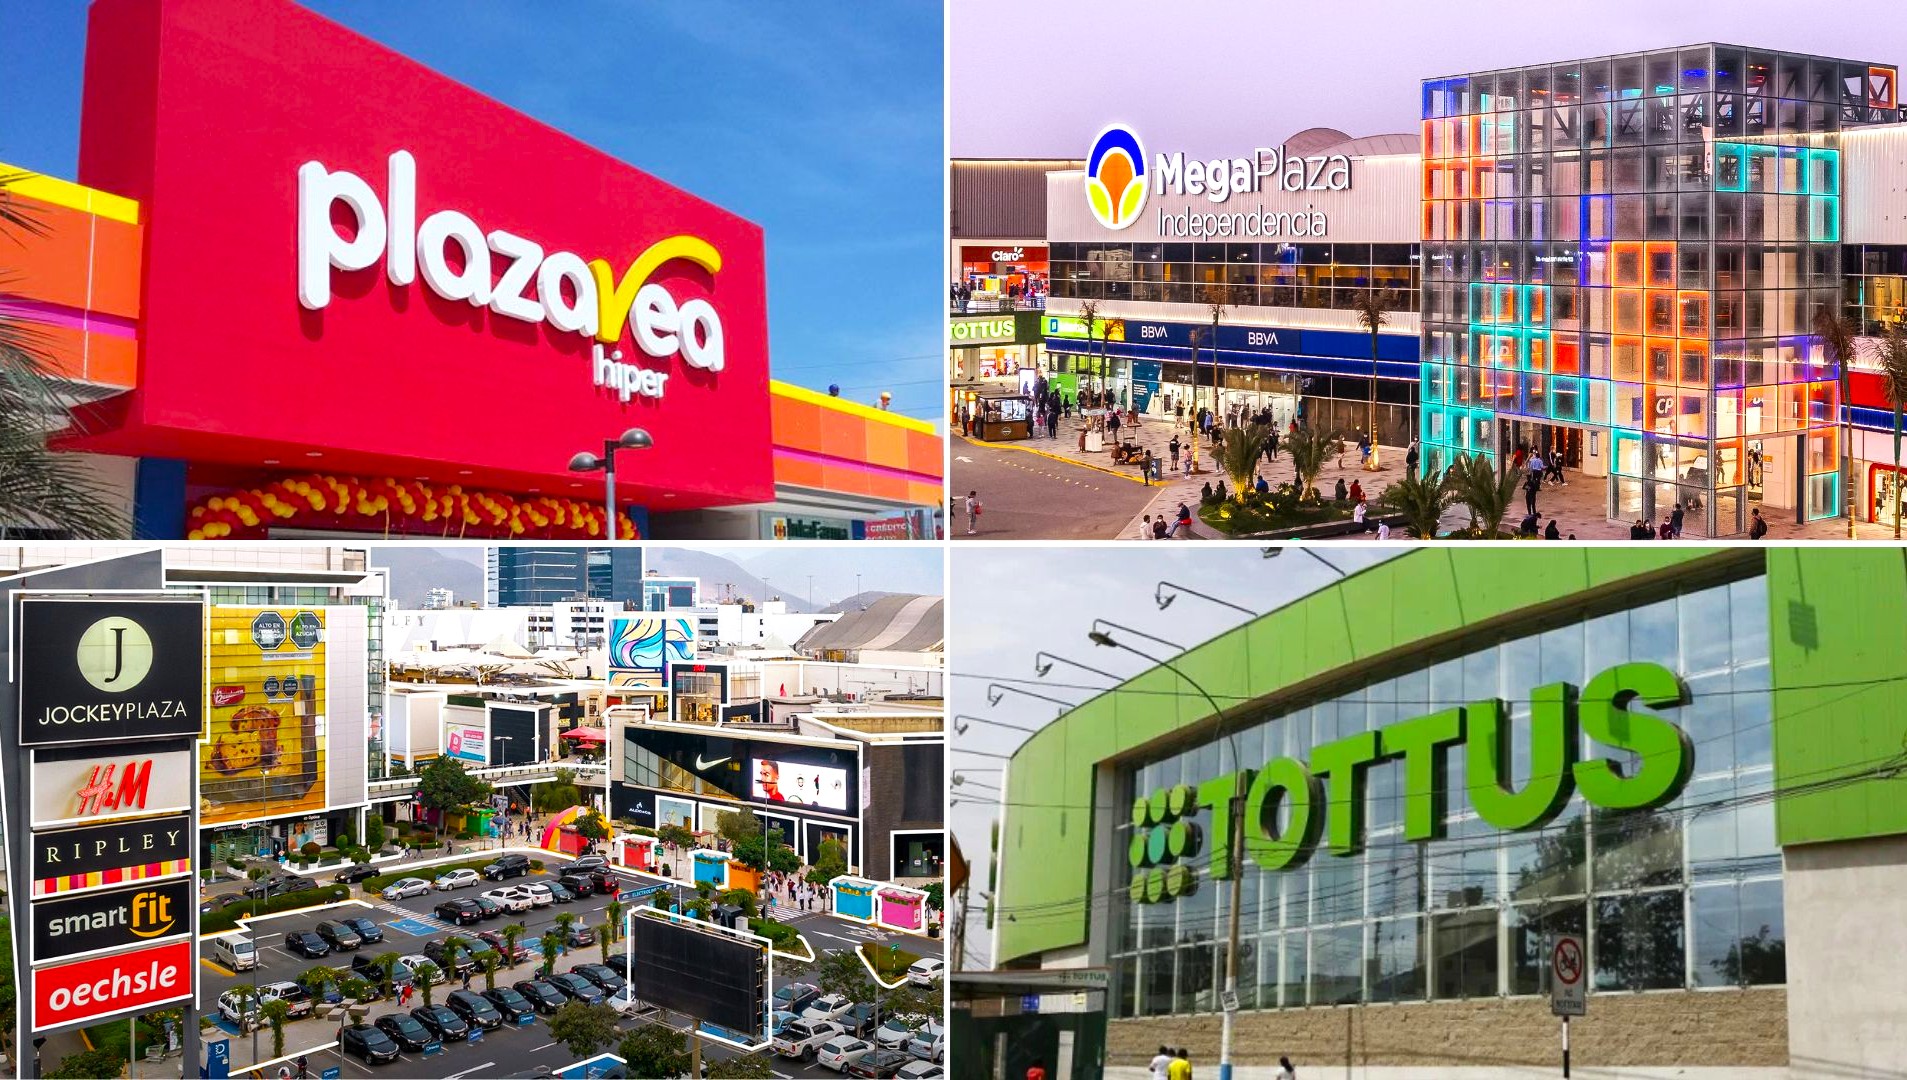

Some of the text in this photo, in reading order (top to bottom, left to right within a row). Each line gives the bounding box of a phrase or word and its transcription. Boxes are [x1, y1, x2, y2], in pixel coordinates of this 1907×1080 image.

[1155, 145, 1352, 203] MegaPlaza
[1157, 204, 1328, 241] Independencia
[298, 149, 724, 371] plazavea
[991, 250, 1019, 261] Claro
[1141, 326, 1168, 338] BBVA
[1248, 332, 1279, 345] BBVA
[593, 344, 669, 401] hiper
[105, 628, 127, 683] J
[38, 700, 187, 725] JOCKEYPLAZA
[77, 760, 153, 815] H&M
[1198, 662, 1694, 880] TOTTUS
[46, 830, 180, 863] RIPLEY
[49, 892, 172, 937] smart fit
[49, 961, 178, 1011] oechsle
